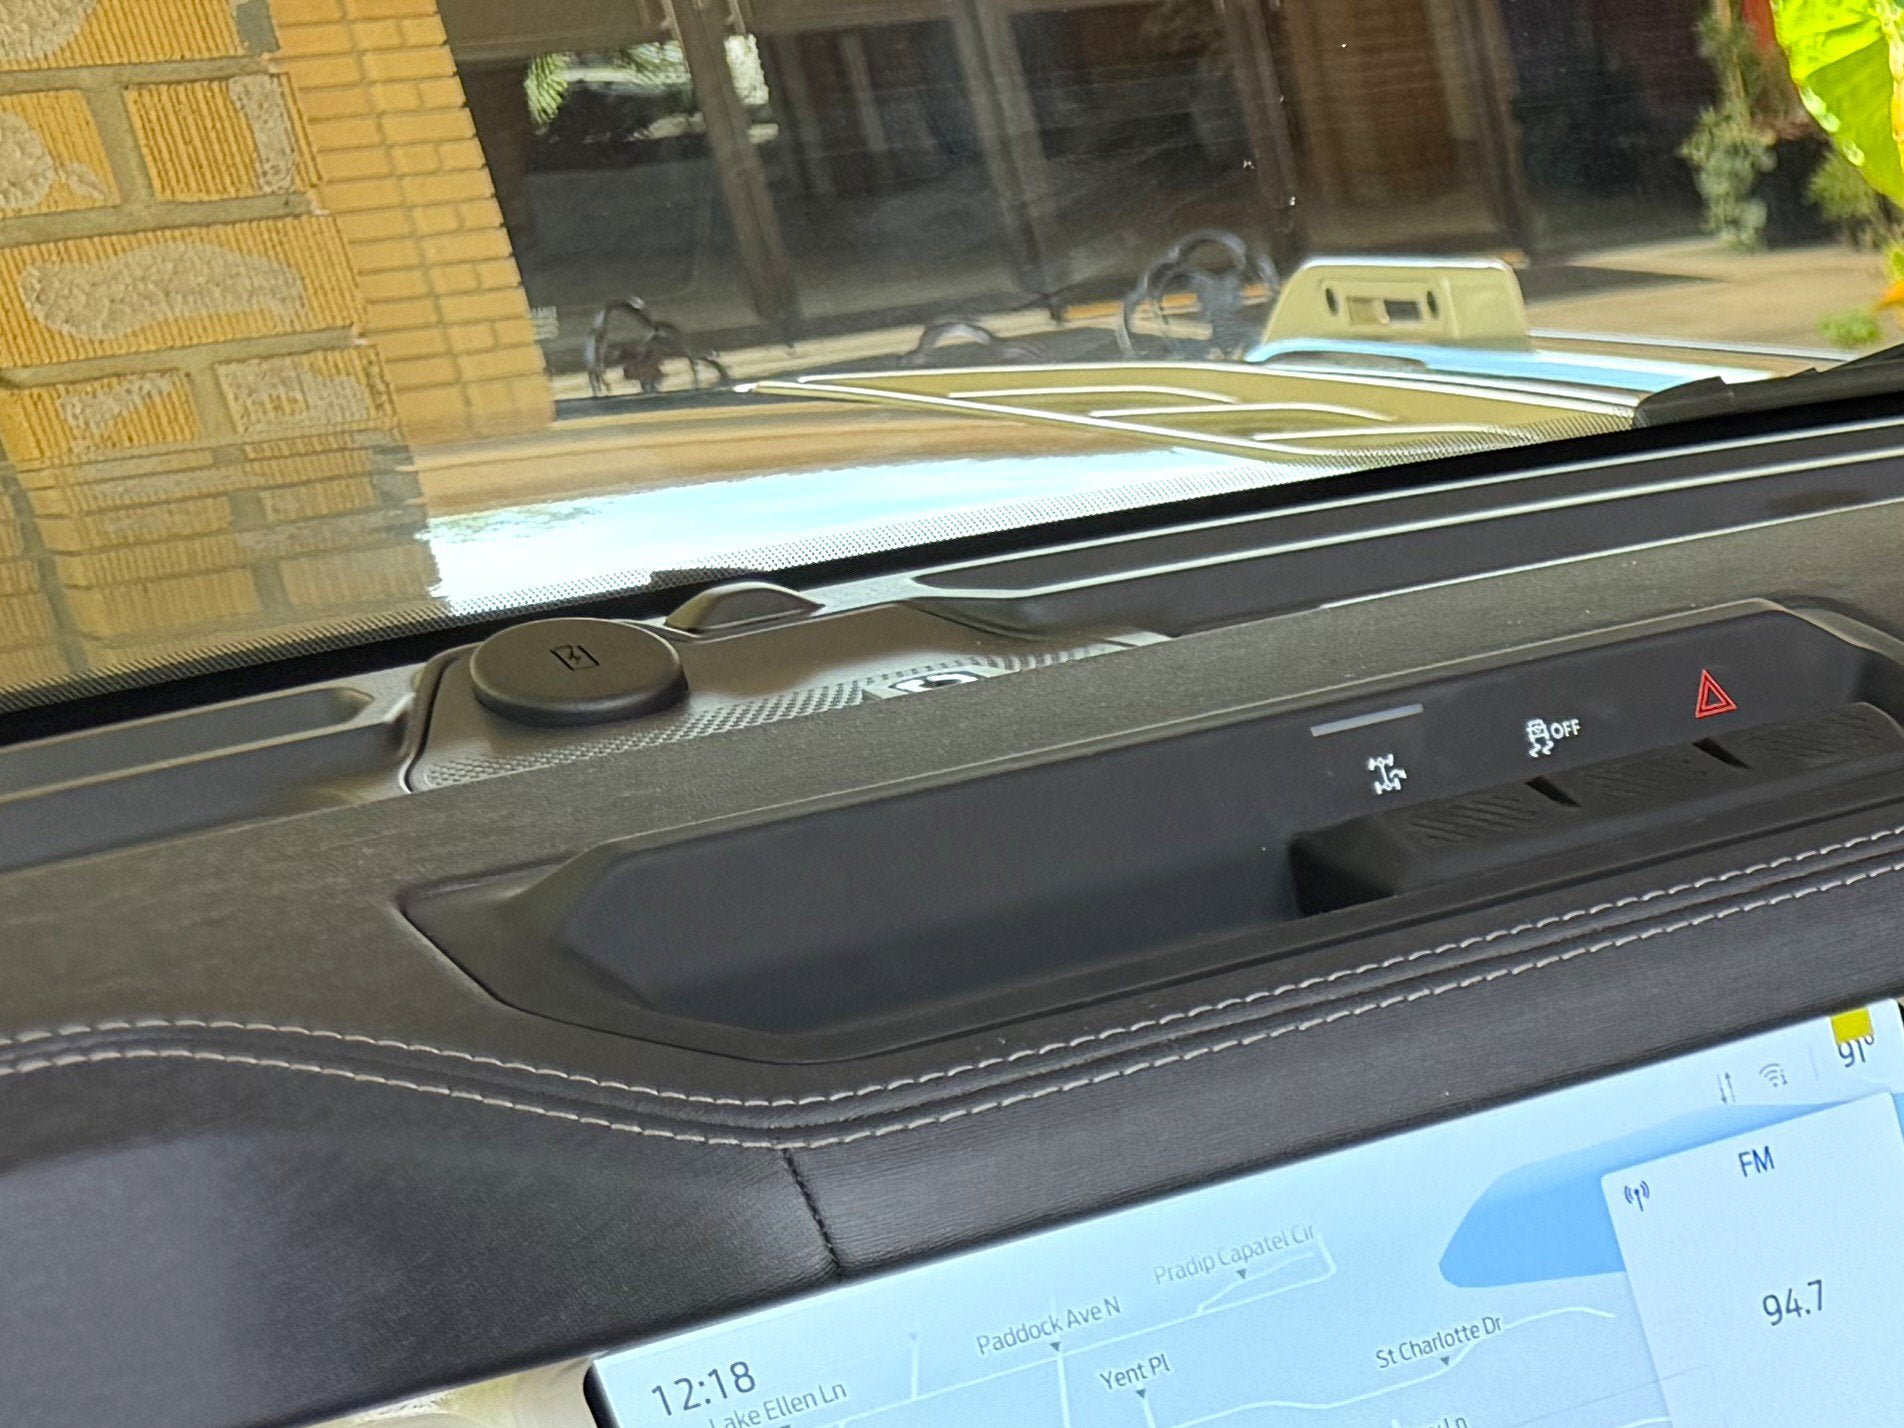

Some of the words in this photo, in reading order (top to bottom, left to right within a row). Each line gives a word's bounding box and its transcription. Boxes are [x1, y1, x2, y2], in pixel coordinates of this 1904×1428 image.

[1550, 717, 1581, 739] OFF
[1739, 1147, 1775, 1178] FM
[1154, 1255, 1215, 1285] Pradip
[1218, 1229, 1289, 1266] Capatel
[1291, 1222, 1315, 1245] Cir
[977, 1315, 1063, 1354] Paddock
[1066, 1305, 1103, 1329] Ave
[1104, 1296, 1121, 1316] N
[1762, 1280, 1825, 1327] 94.7
[1376, 1348, 1398, 1369] St
[1399, 1324, 1481, 1361] Charlotte
[1482, 1316, 1502, 1335] Dr
[651, 1361, 756, 1416] 12:18
[1100, 1362, 1147, 1391] Yent
[1149, 1353, 1171, 1376] Pl
[763, 1390, 818, 1420] Ellen
[818, 1383, 847, 1404] Ln
